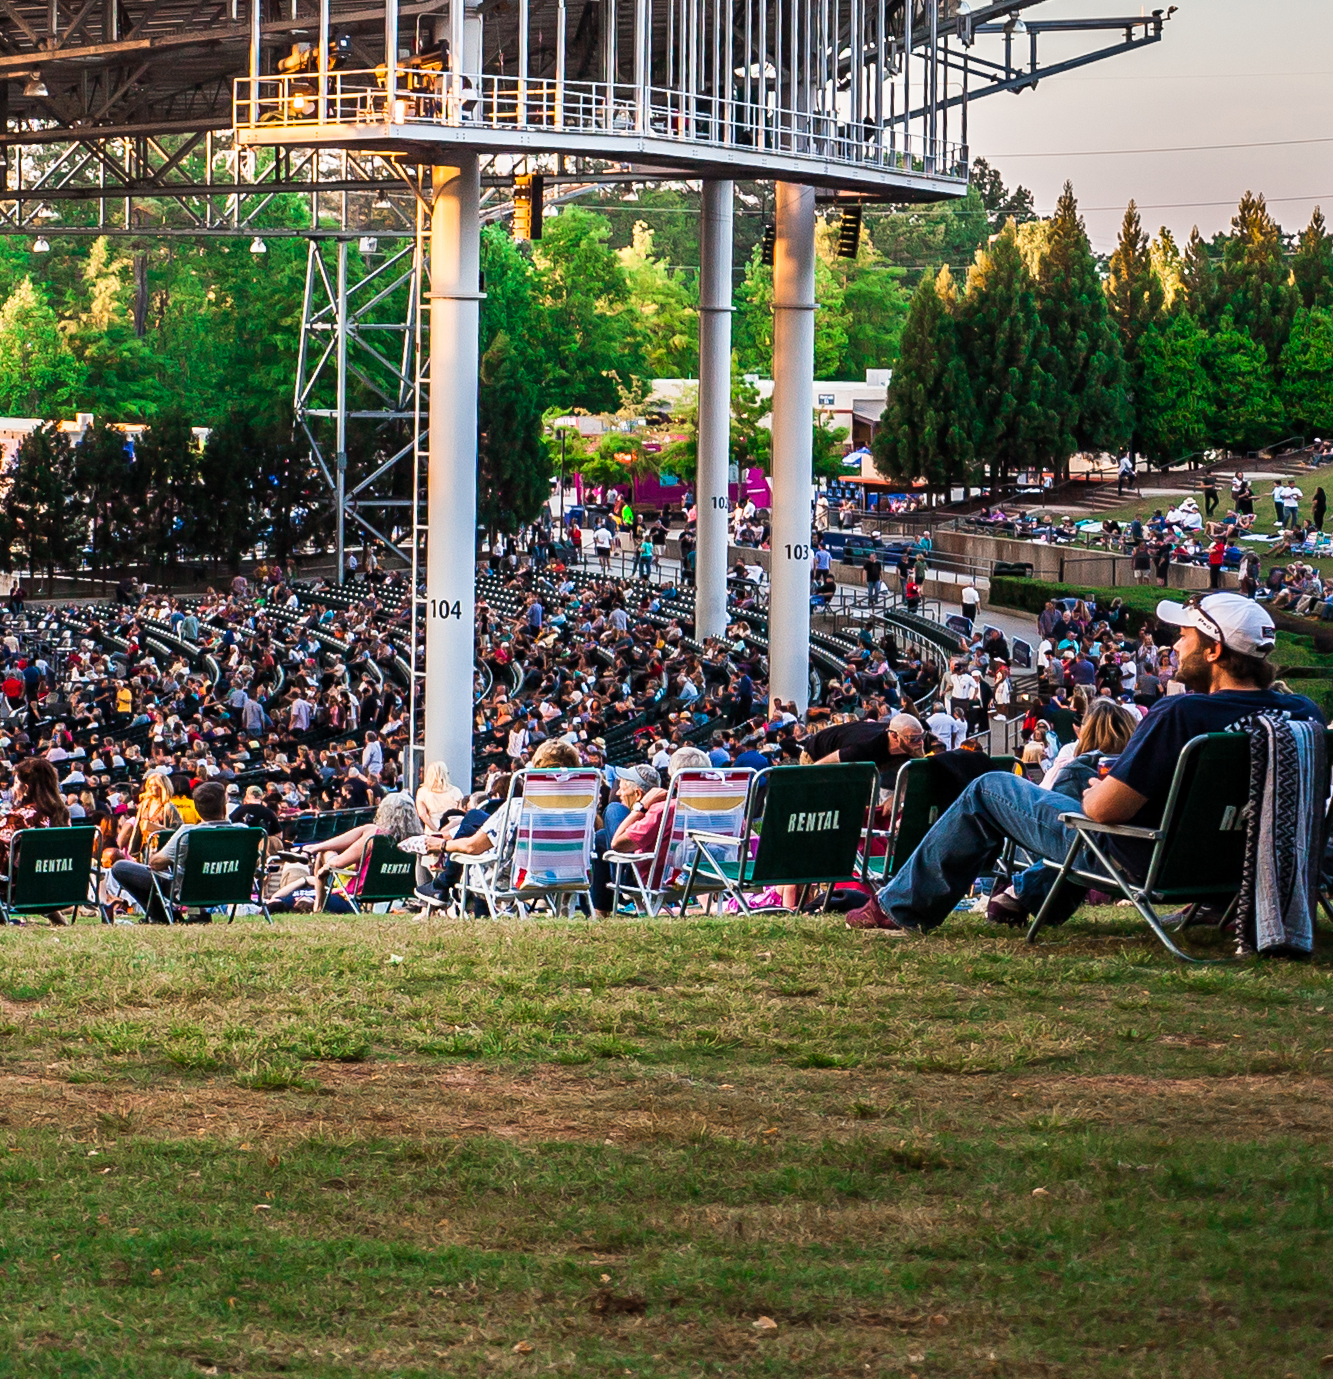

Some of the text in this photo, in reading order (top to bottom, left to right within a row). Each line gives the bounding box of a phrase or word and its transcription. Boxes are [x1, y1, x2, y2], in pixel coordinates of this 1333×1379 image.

[785, 544, 809, 560] 103
[431, 599, 462, 619] 104
[788, 810, 840, 832] RENTAL
[35, 858, 73, 872] RENTAL
[202, 860, 239, 874] RENTAL
[380, 863, 411, 874] RENTAL
